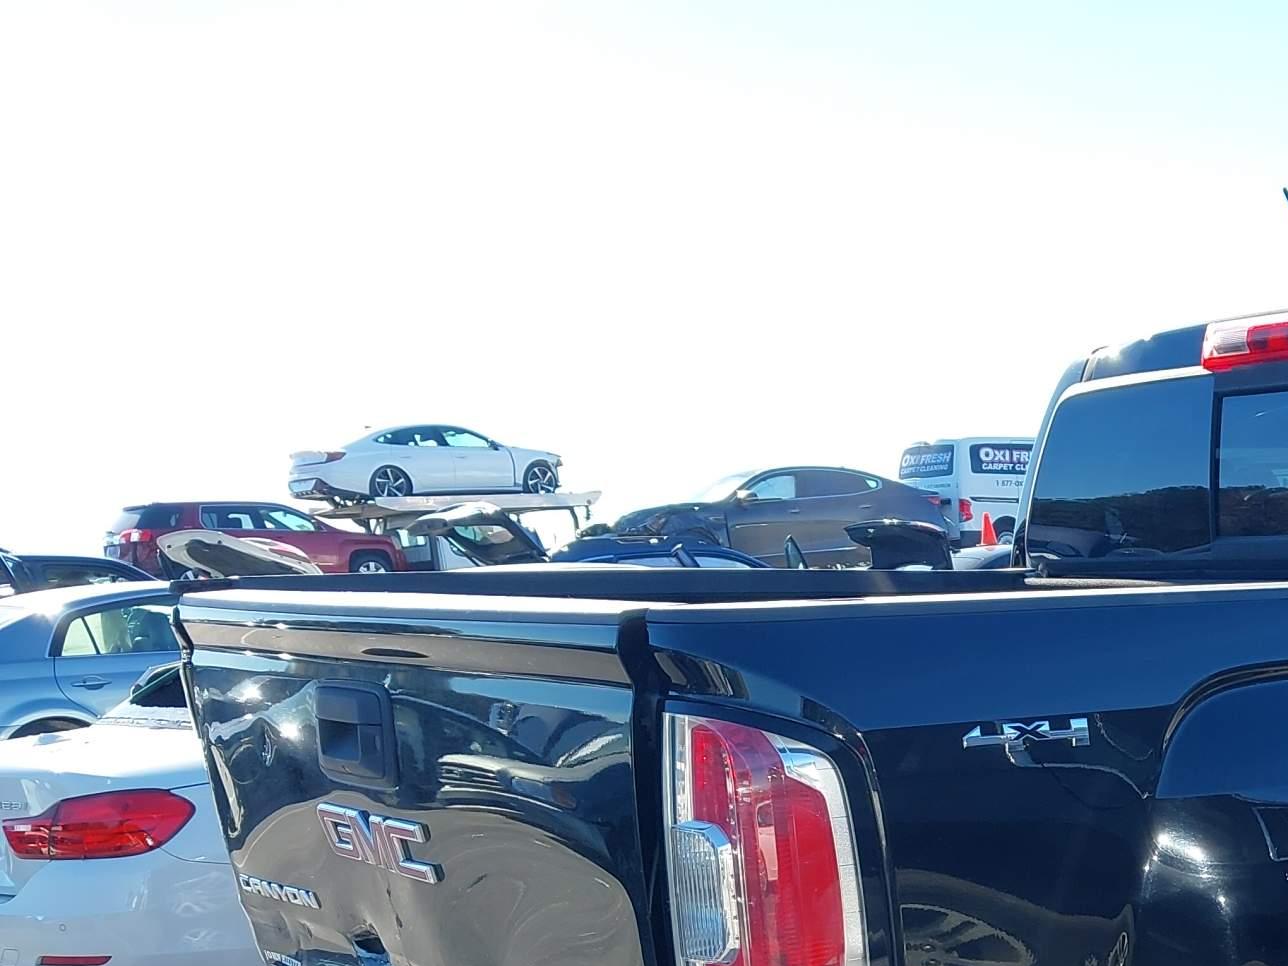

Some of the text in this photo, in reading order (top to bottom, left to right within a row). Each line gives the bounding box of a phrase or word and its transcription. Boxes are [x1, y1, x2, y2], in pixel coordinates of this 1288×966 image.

[920, 451, 952, 465] FRESH
[979, 447, 1010, 461] OXI
[982, 463, 1014, 471] CARPET
[317, 802, 445, 885] GMC
[239, 873, 321, 910] CANYON
